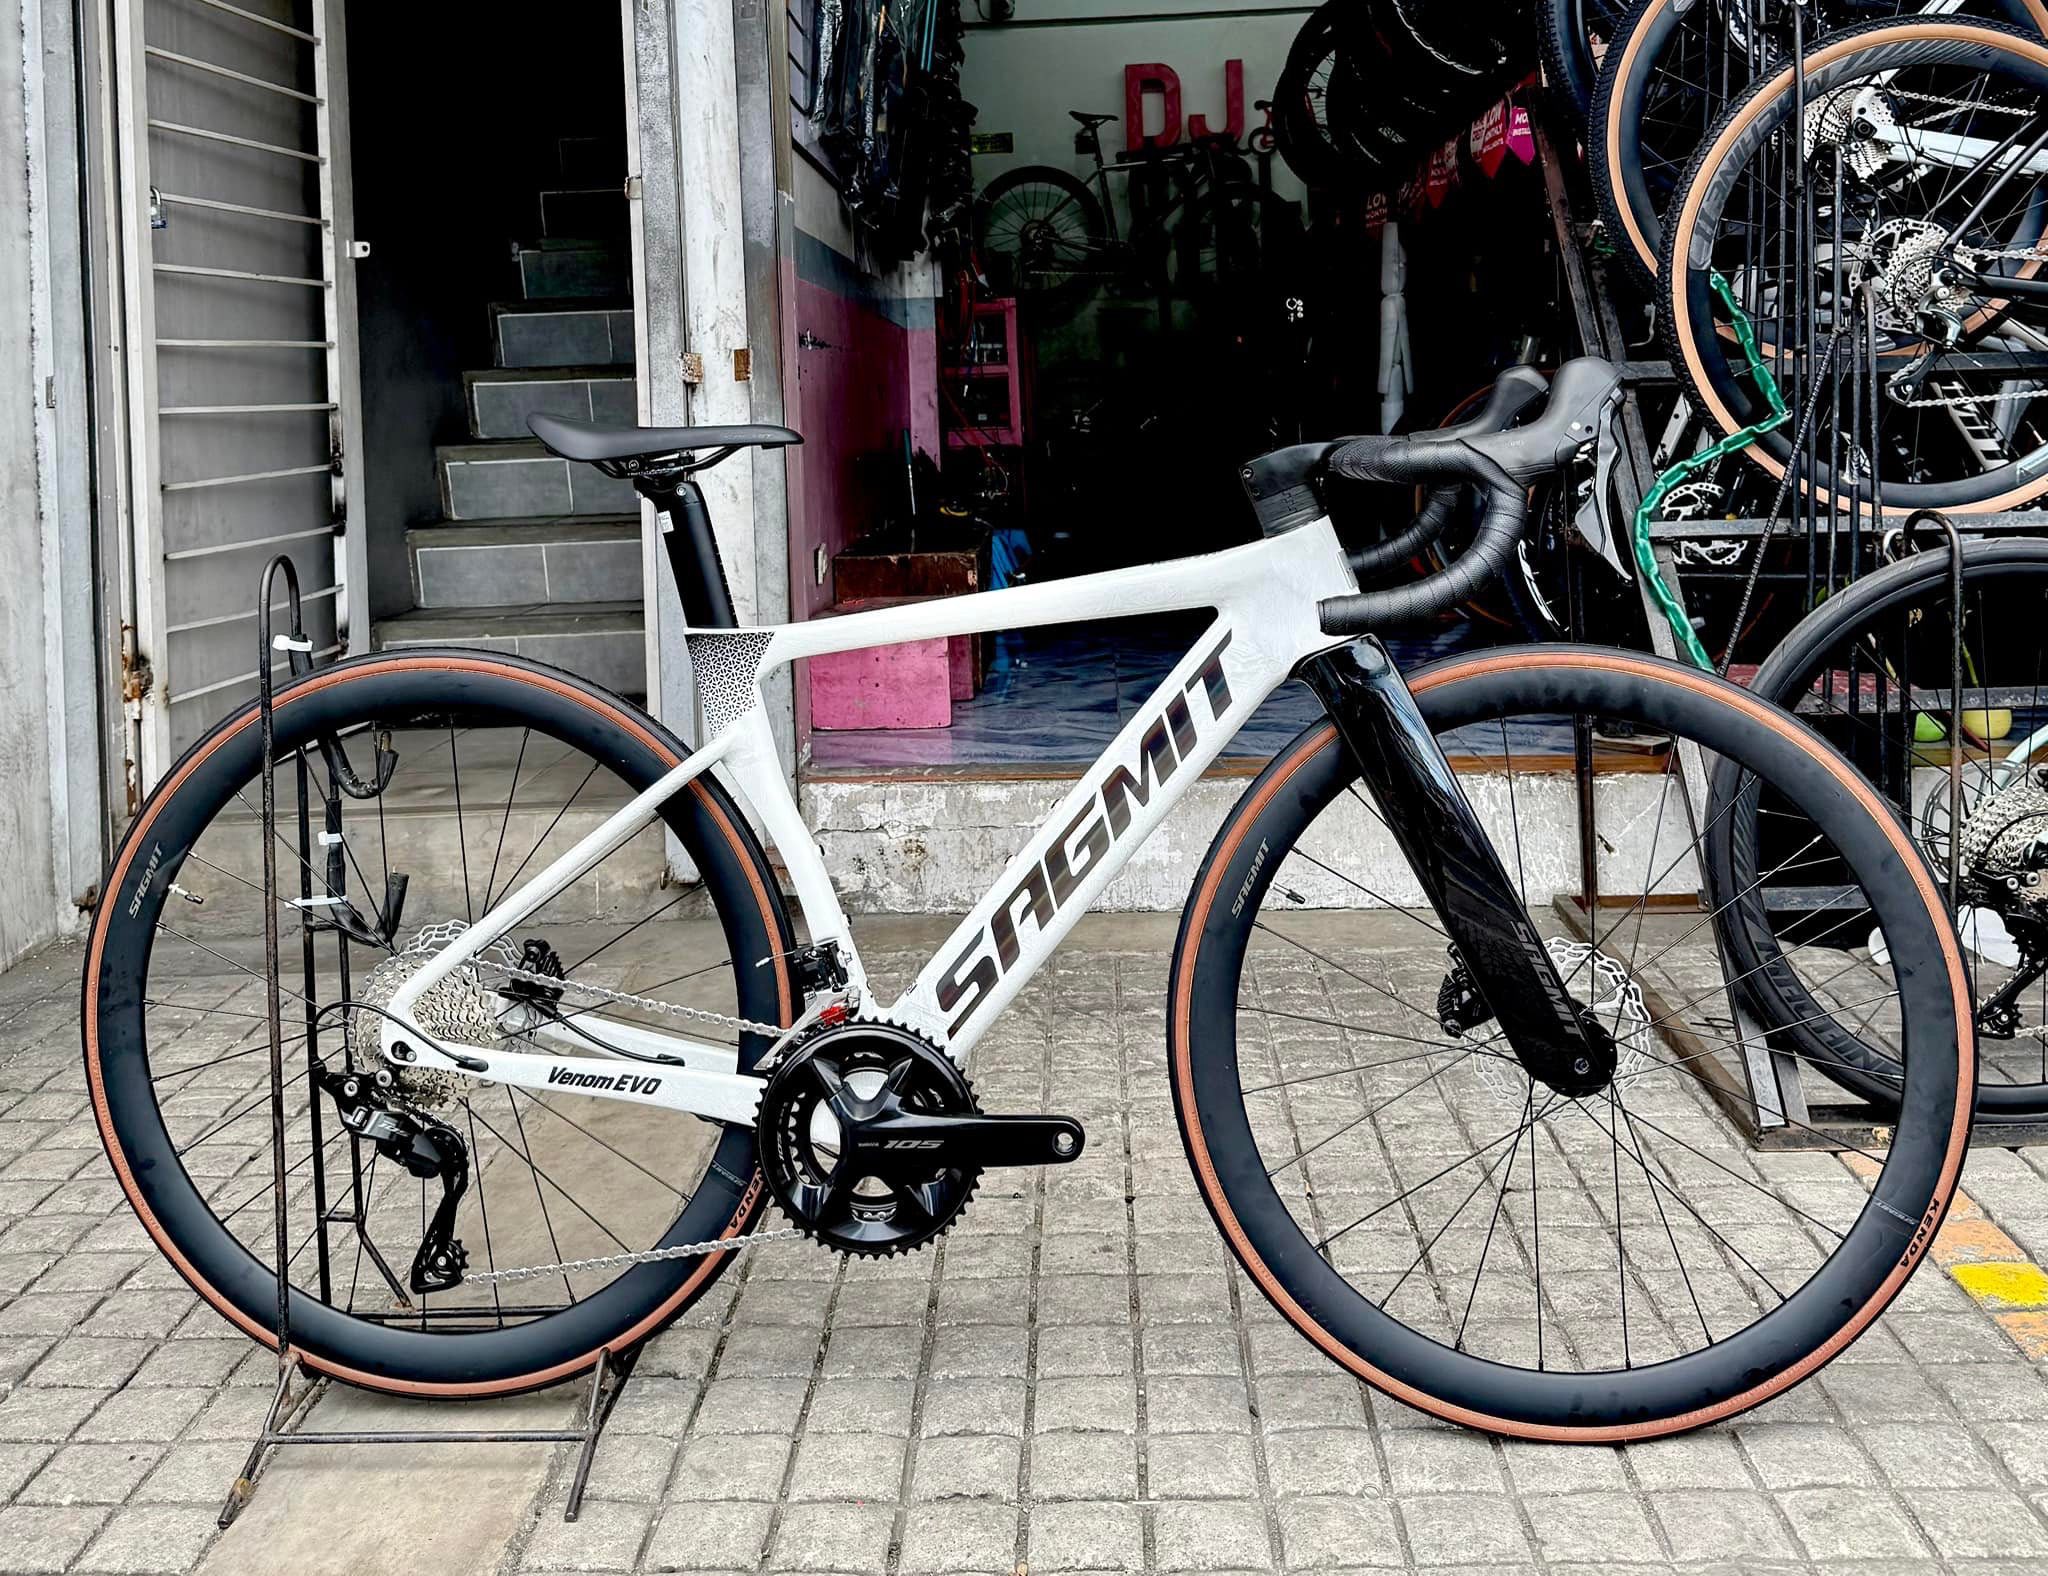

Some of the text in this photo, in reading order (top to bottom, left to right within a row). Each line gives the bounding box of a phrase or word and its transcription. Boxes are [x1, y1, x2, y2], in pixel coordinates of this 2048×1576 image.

[1125, 59, 1244, 152] DJ
[936, 628, 1233, 1041] SAGMIT
[129, 842, 162, 919] SAGMIT
[1232, 837, 1269, 919] SAGMIT
[883, 1139, 945, 1149] 105
[1900, 1198, 1940, 1267] KENDA
